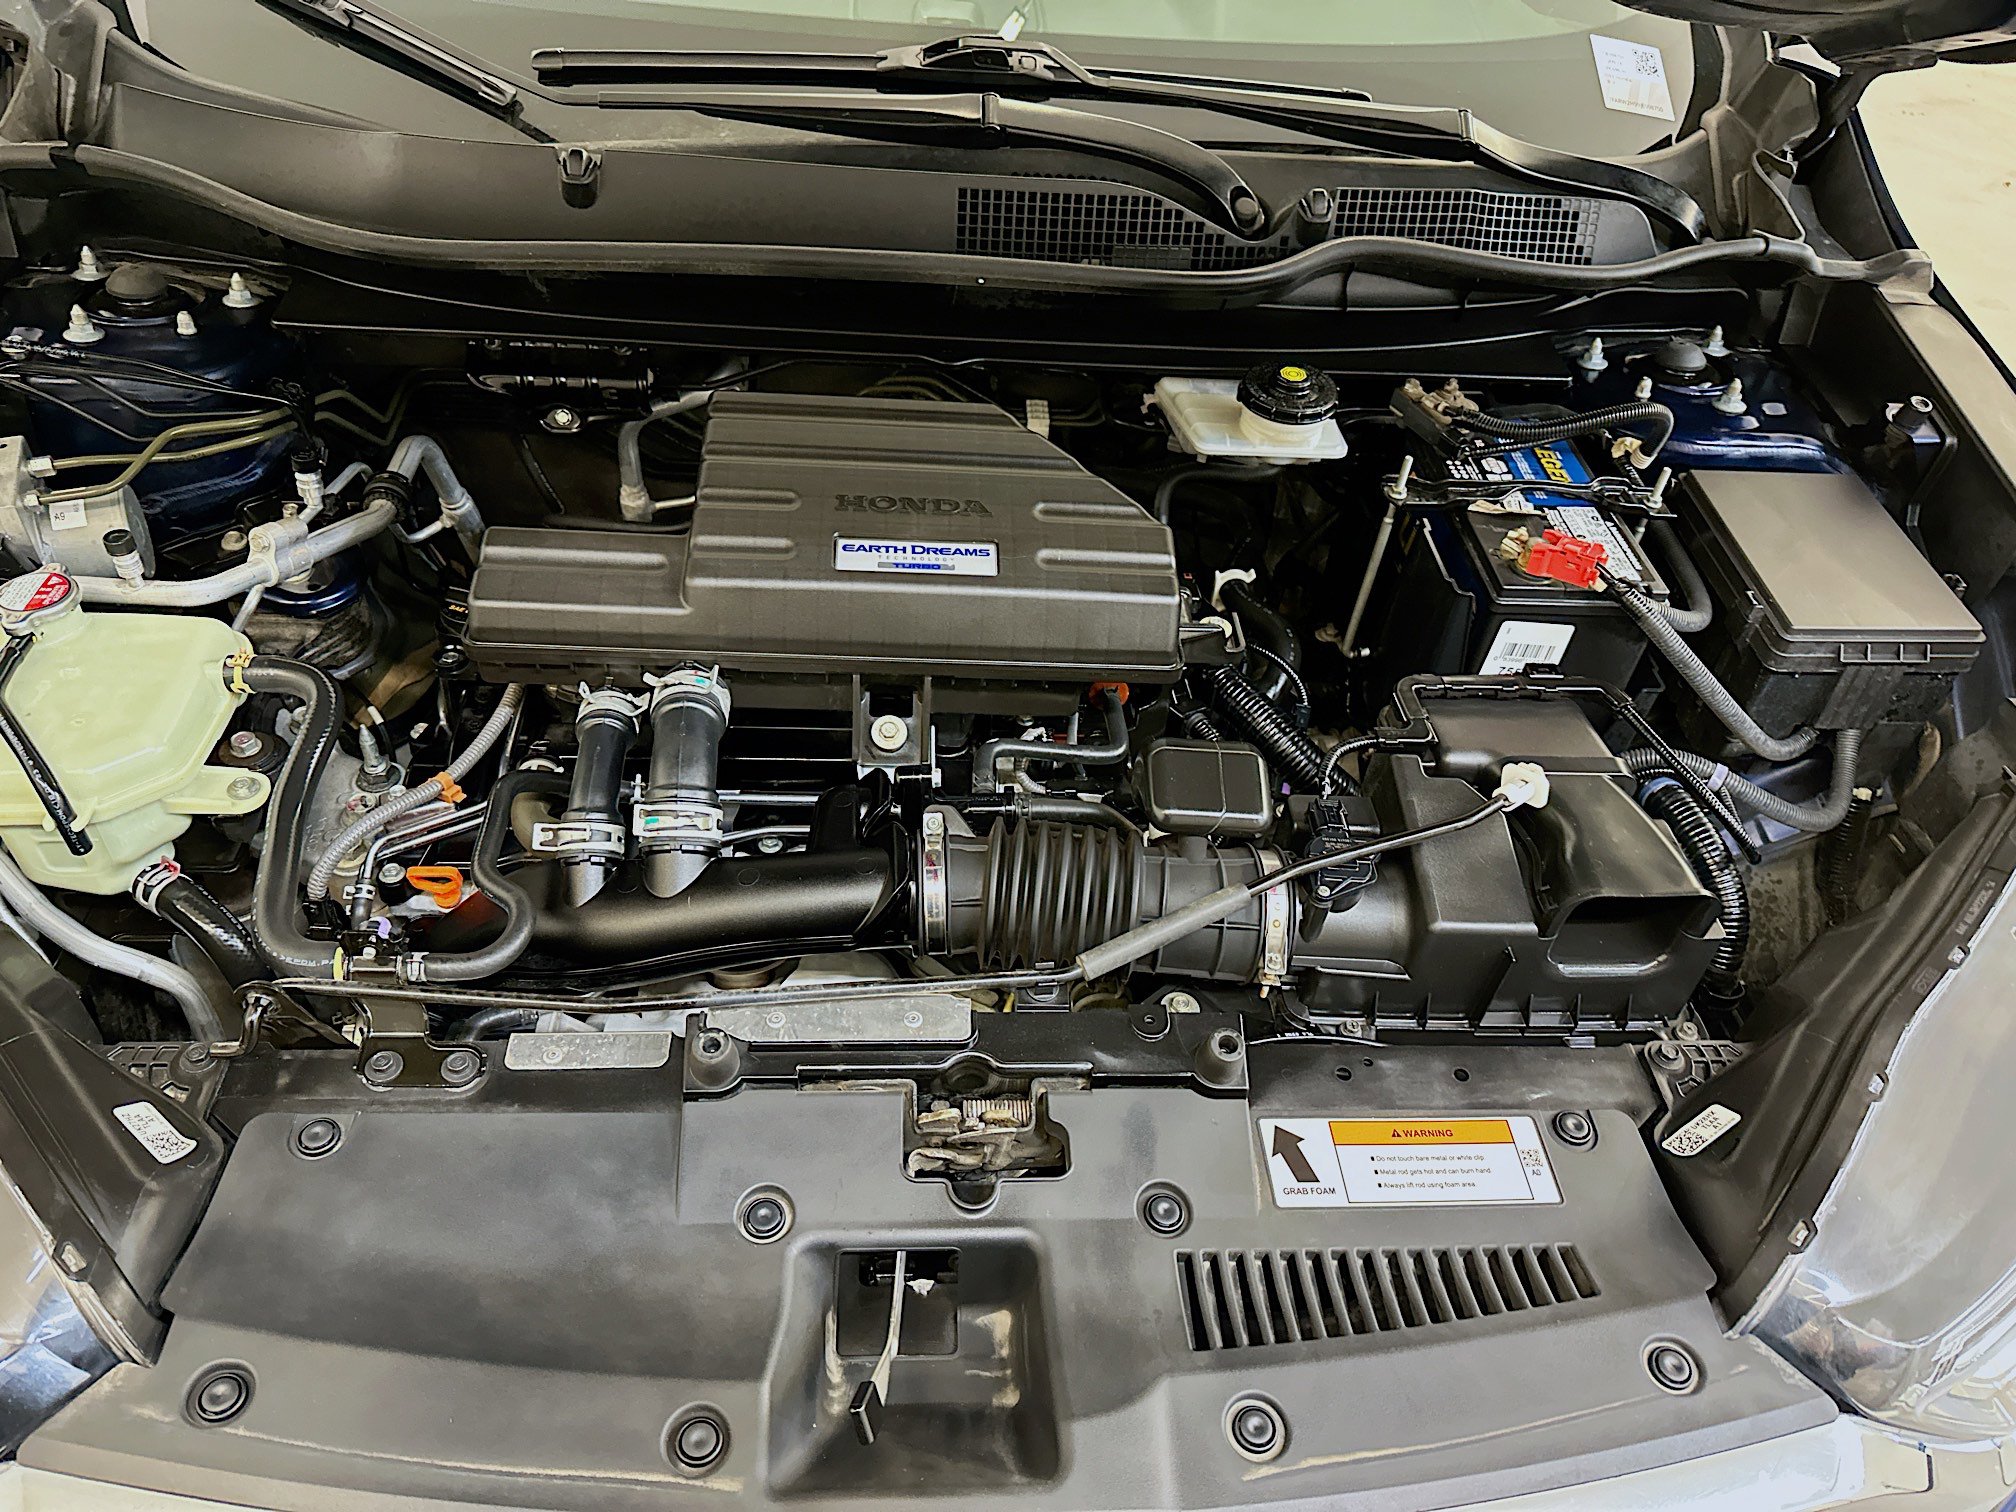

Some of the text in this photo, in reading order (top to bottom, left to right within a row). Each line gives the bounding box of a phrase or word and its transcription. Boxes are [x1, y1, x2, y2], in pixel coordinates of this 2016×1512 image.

[834, 494, 993, 518] HONDA
[841, 544, 991, 557] EARTH DREAMS
[1402, 1129, 1454, 1138] WARNING
[1397, 1154, 1415, 1162] touch
[1415, 1154, 1430, 1162] bare
[1473, 1154, 1485, 1162] clip
[1409, 1168, 1423, 1176] gets
[1383, 1182, 1406, 1190] Always
[1426, 1181, 1444, 1189] using
[1283, 1187, 1337, 1196] GRAB FOAM
